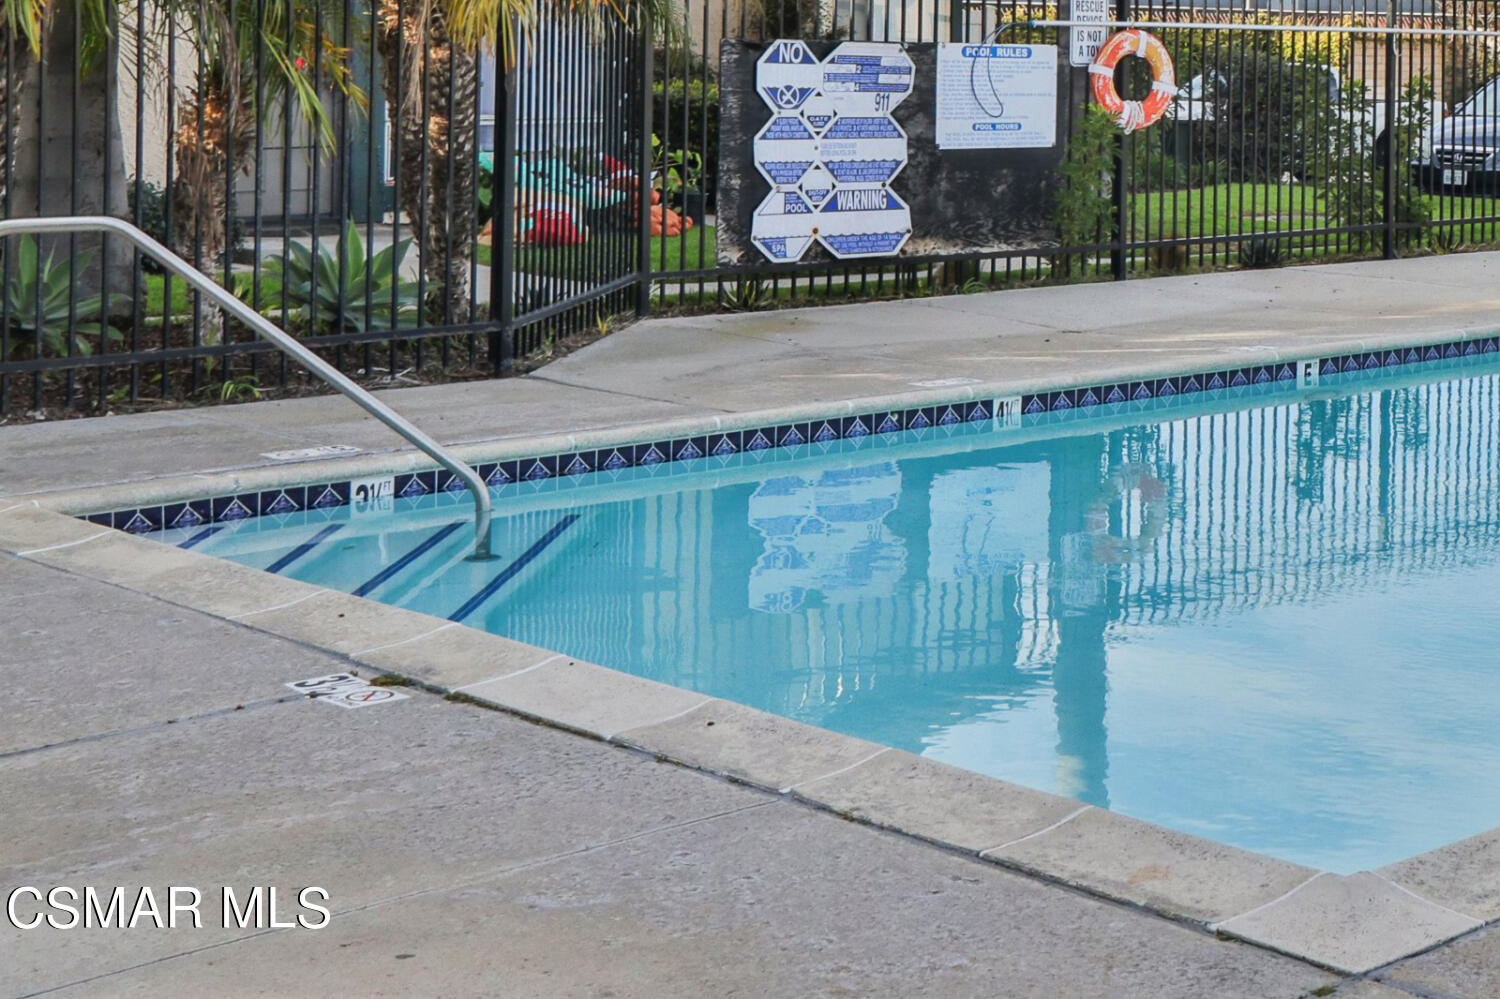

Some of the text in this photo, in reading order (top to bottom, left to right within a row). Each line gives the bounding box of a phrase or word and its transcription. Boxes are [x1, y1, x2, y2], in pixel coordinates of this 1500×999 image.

[1076, 0, 1104, 12] RESCUE
[1077, 30, 1102, 41] IS NOT
[778, 43, 803, 63] NO
[966, 47, 1028, 58] POOL RULES
[1079, 45, 1084, 56] A
[875, 92, 890, 111] 911
[836, 189, 888, 210] WARNING
[785, 203, 808, 213] POOL
[771, 244, 785, 253] SPA
